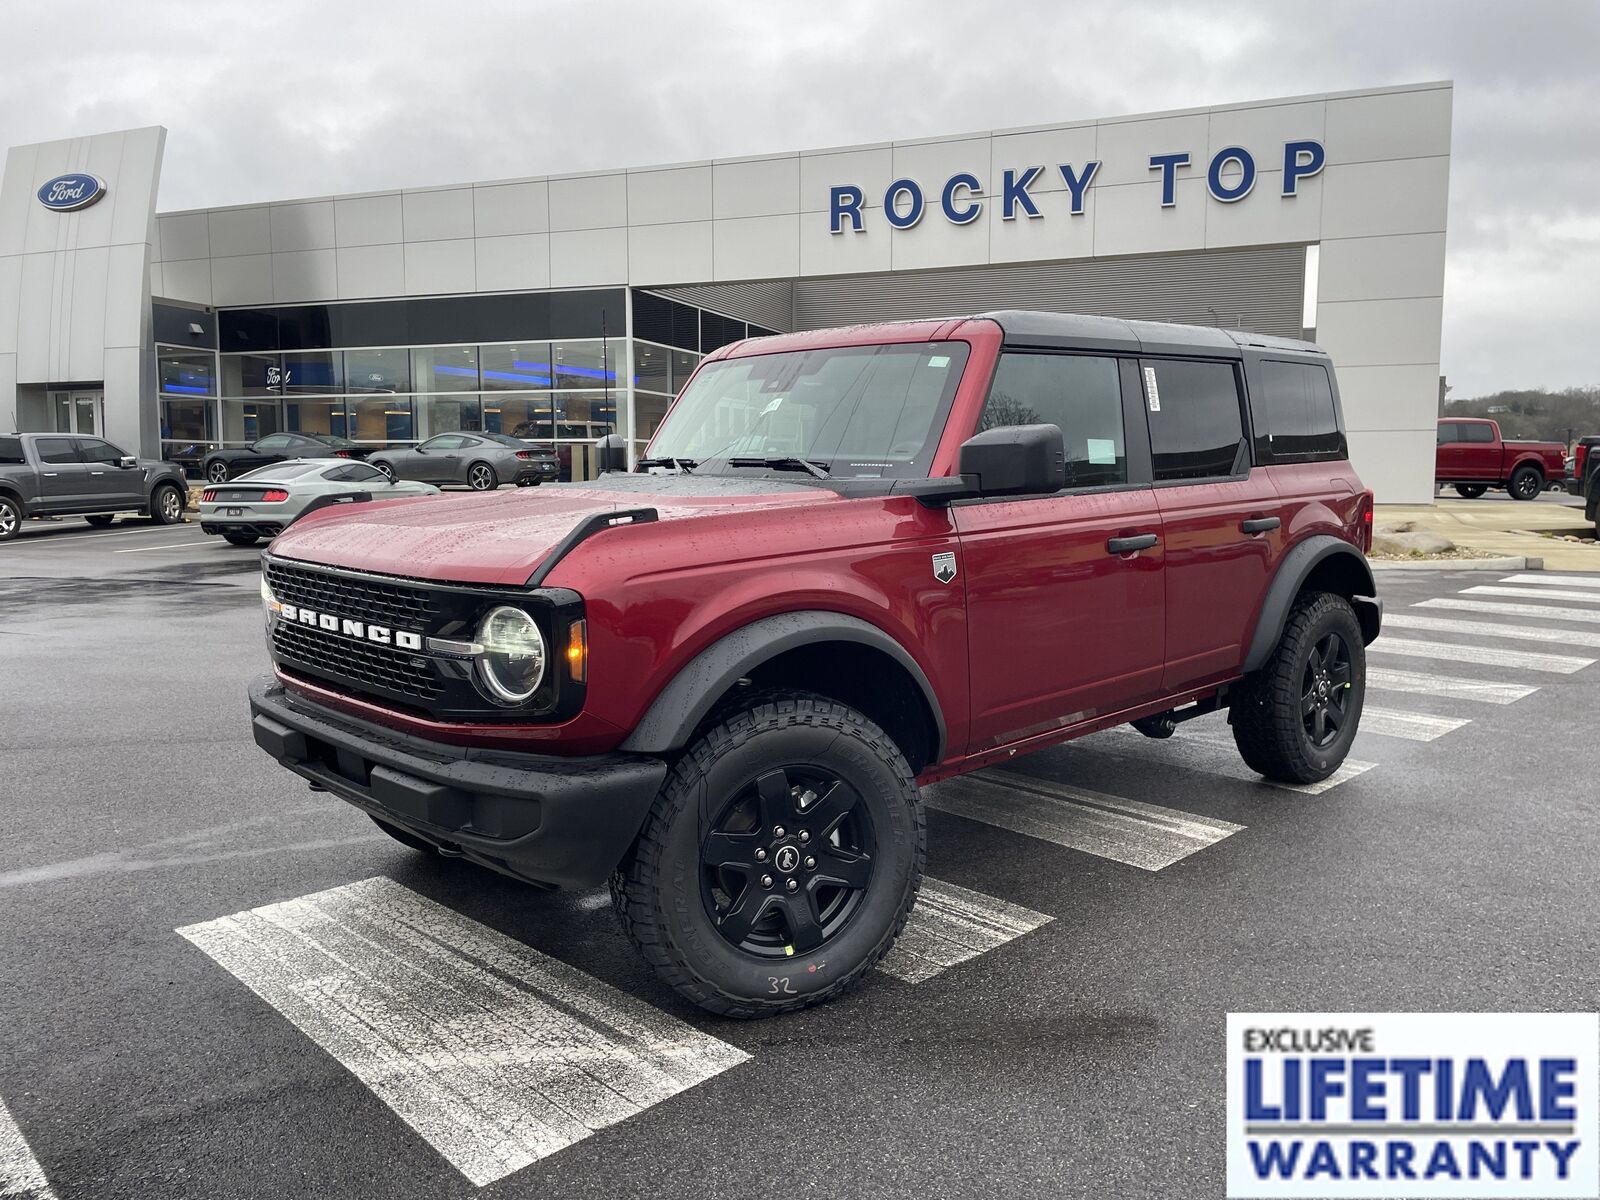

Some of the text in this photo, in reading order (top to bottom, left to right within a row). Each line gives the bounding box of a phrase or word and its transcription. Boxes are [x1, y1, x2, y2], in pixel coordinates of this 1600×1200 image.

[48, 180, 85, 202] Ford
[829, 140, 1326, 234] ROCKY TOP
[280, 604, 422, 650] BRONCO
[768, 976, 798, 994] 32
